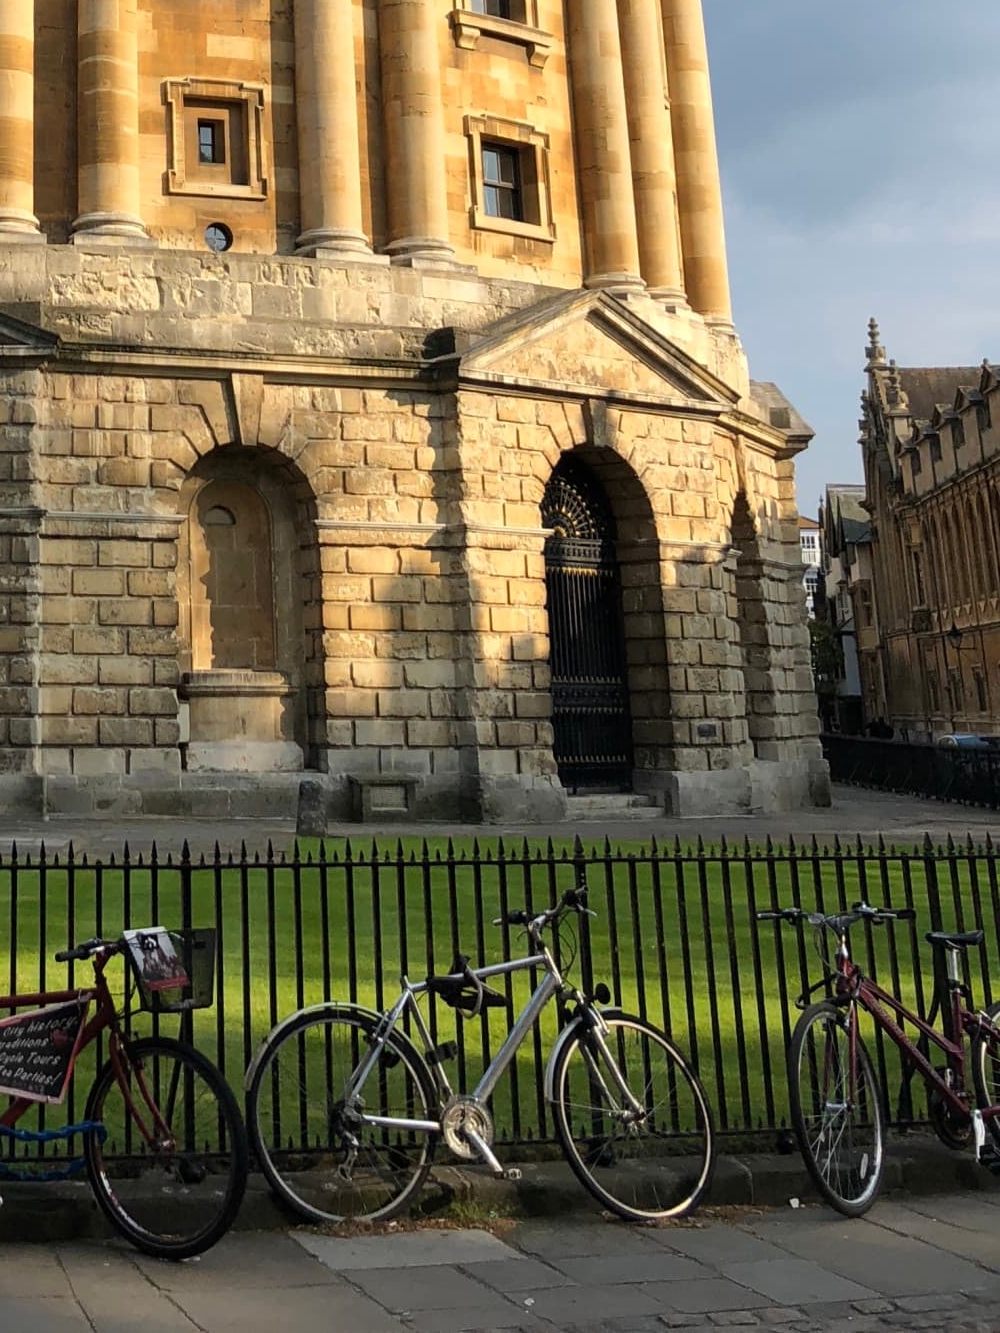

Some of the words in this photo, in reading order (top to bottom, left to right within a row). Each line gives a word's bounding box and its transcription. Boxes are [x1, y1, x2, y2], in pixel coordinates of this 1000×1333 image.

[3, 1025, 25, 1037] City
[26, 1051, 61, 1066] Tours
[13, 1067, 63, 1086] Parties!
